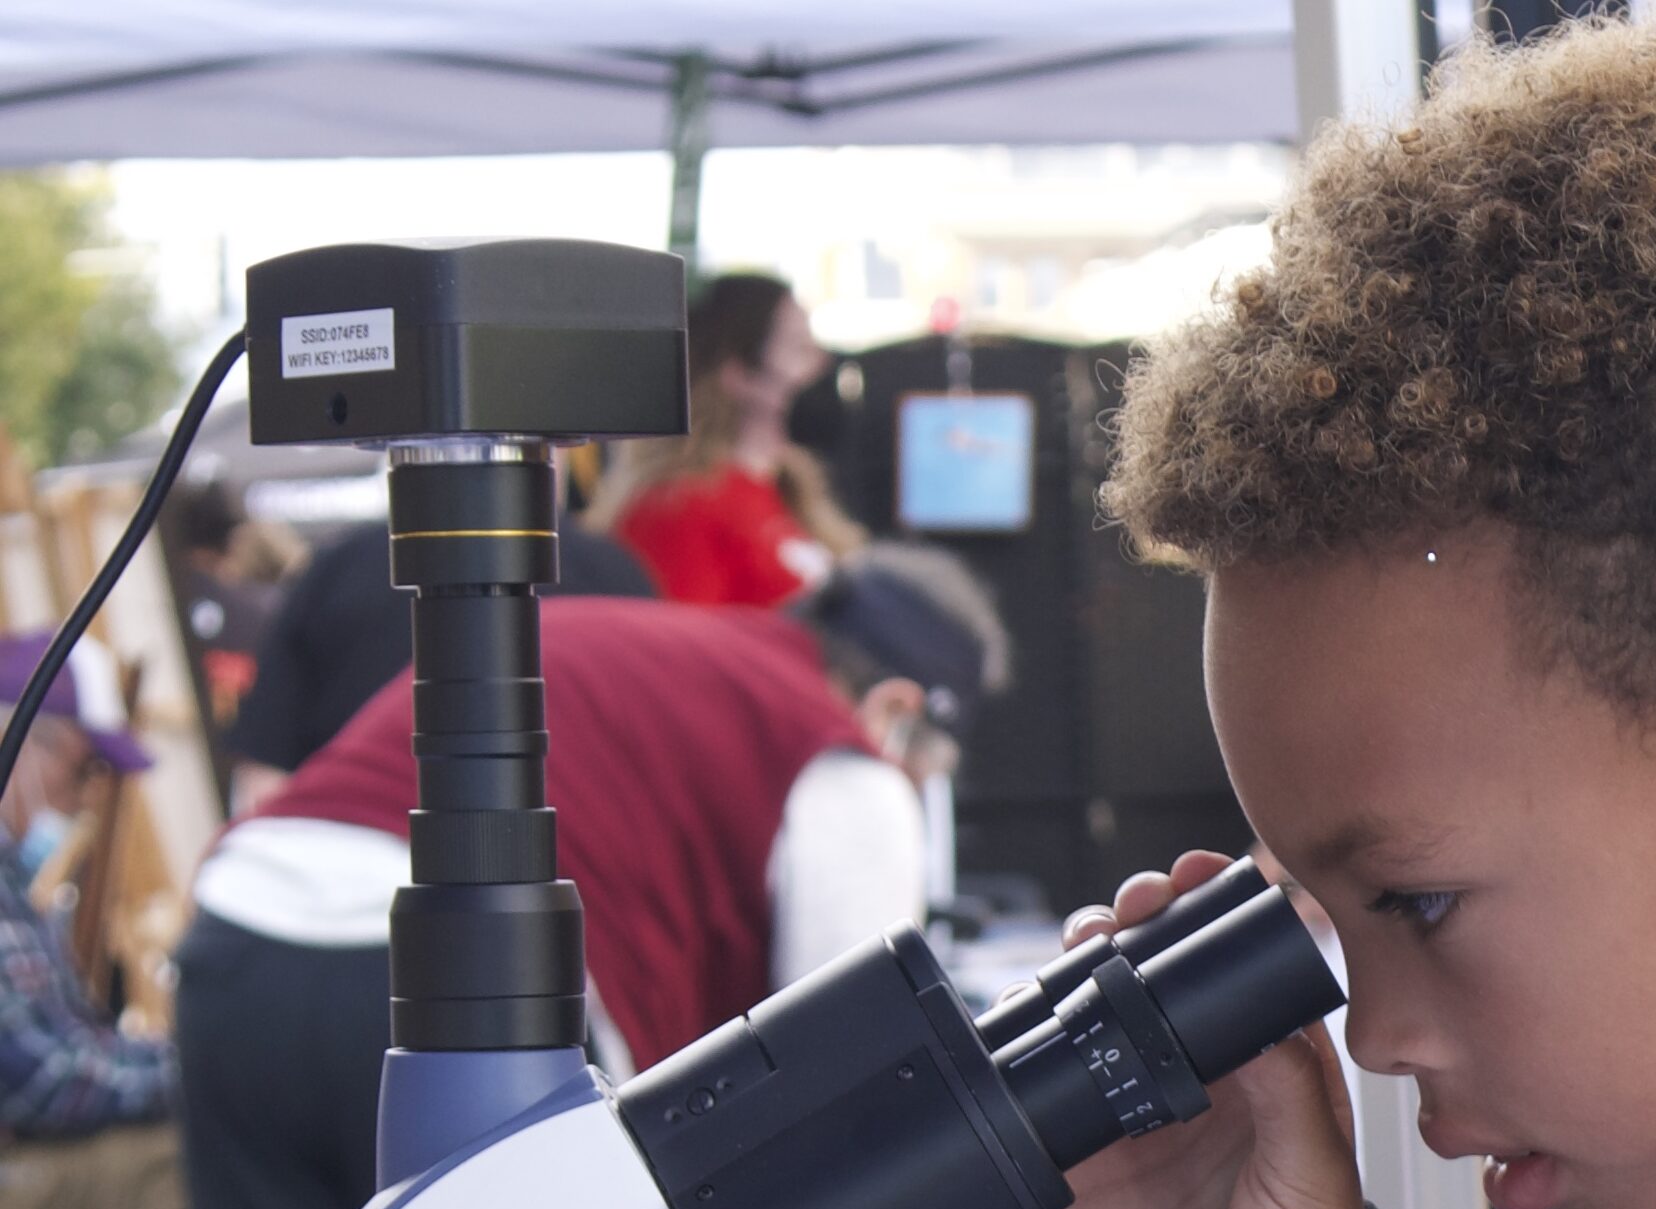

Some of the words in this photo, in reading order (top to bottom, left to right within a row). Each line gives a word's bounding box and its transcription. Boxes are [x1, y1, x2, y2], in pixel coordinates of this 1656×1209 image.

[301, 323, 370, 344] SSID:074FE8
[287, 352, 312, 368] WIFI
[314, 345, 390, 367] KEY:12345678
